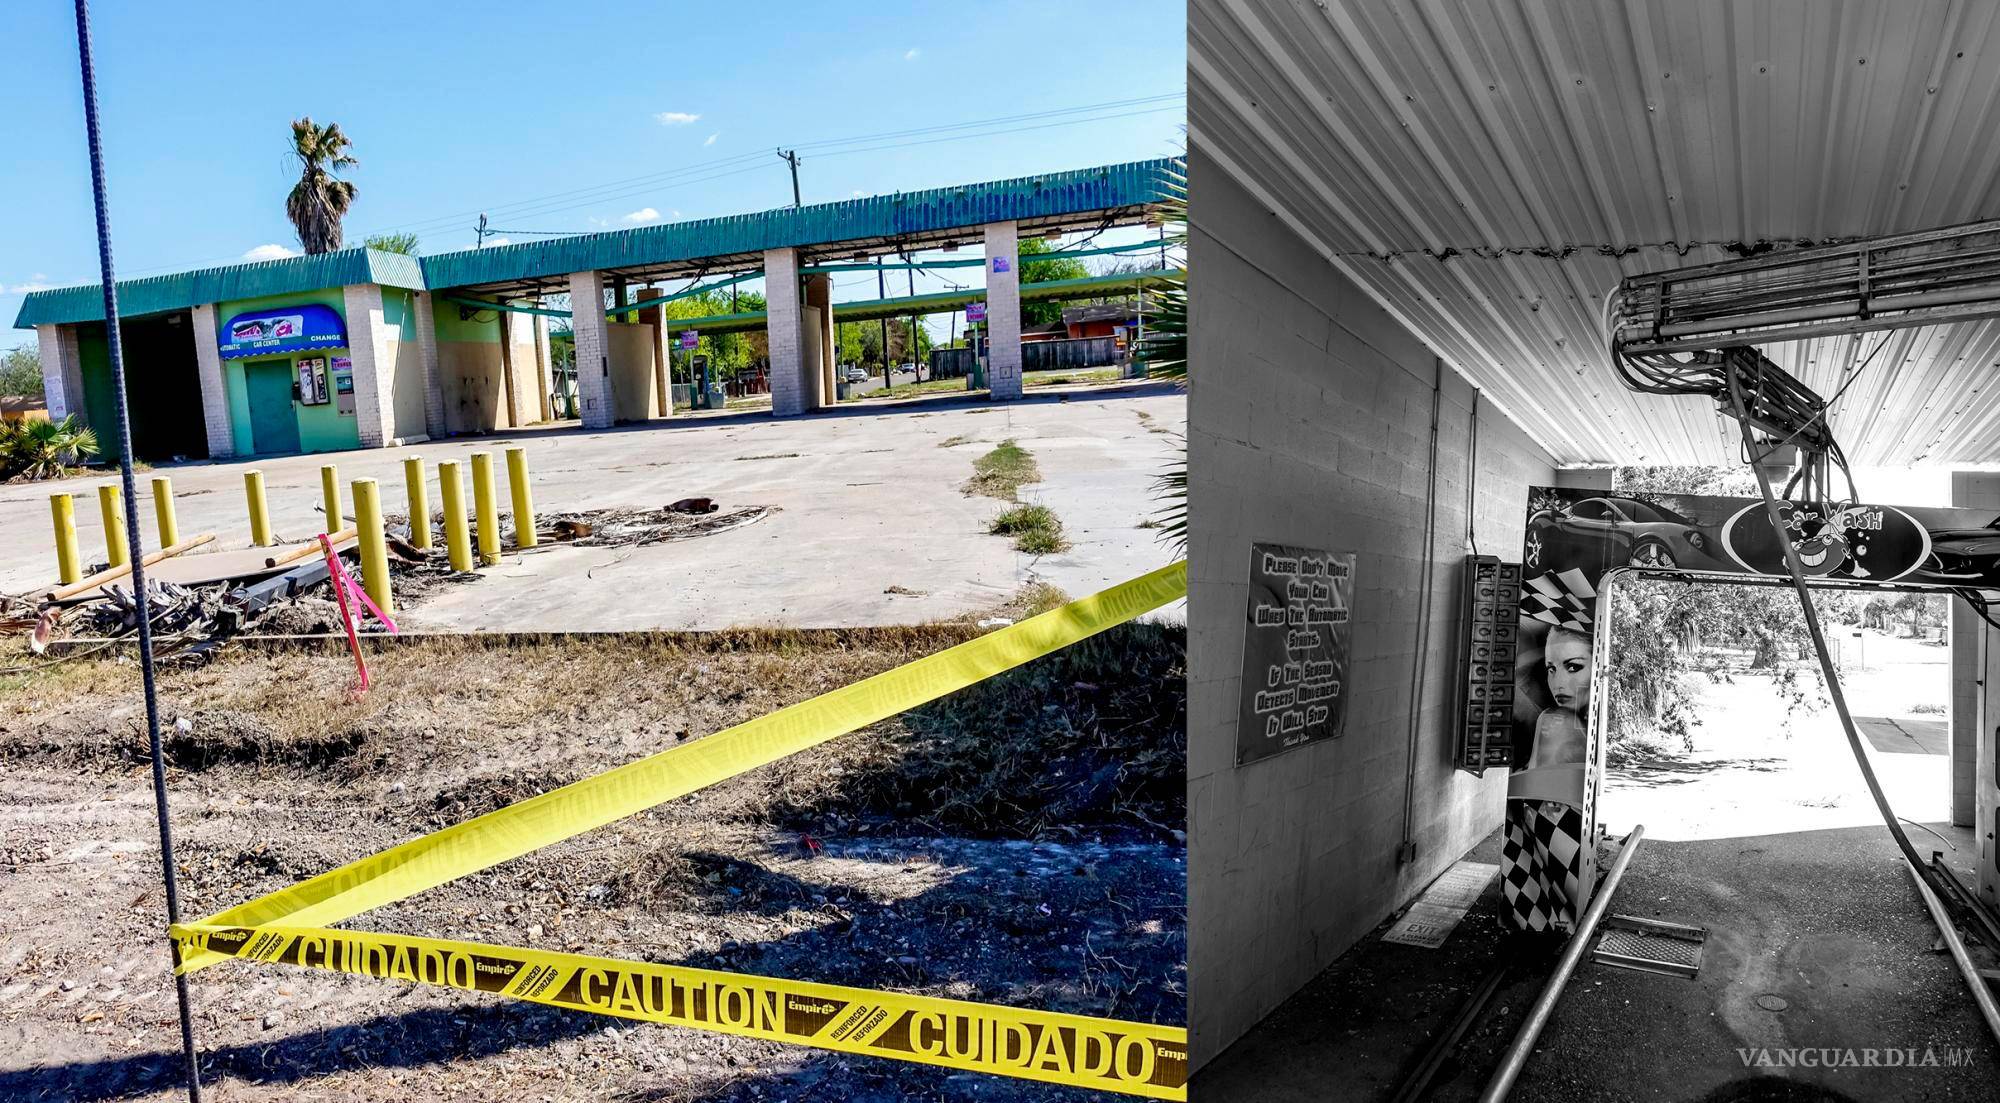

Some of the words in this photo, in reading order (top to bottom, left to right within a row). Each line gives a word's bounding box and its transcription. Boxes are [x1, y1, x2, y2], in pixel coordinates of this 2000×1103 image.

[310, 334, 340, 342] CHANGE
[247, 932, 270, 958] NFORCED
[1406, 924, 1438, 934] EXIT
[298, 935, 476, 991] CUIDADO
[476, 961, 517, 975] Empire
[580, 966, 786, 1033] CAUTION
[788, 1000, 836, 1014] Empire
[830, 1004, 868, 1040] REINFORCED
[852, 1008, 888, 1043] REFORZADO
[910, 1010, 1156, 1085] CUIDADO
